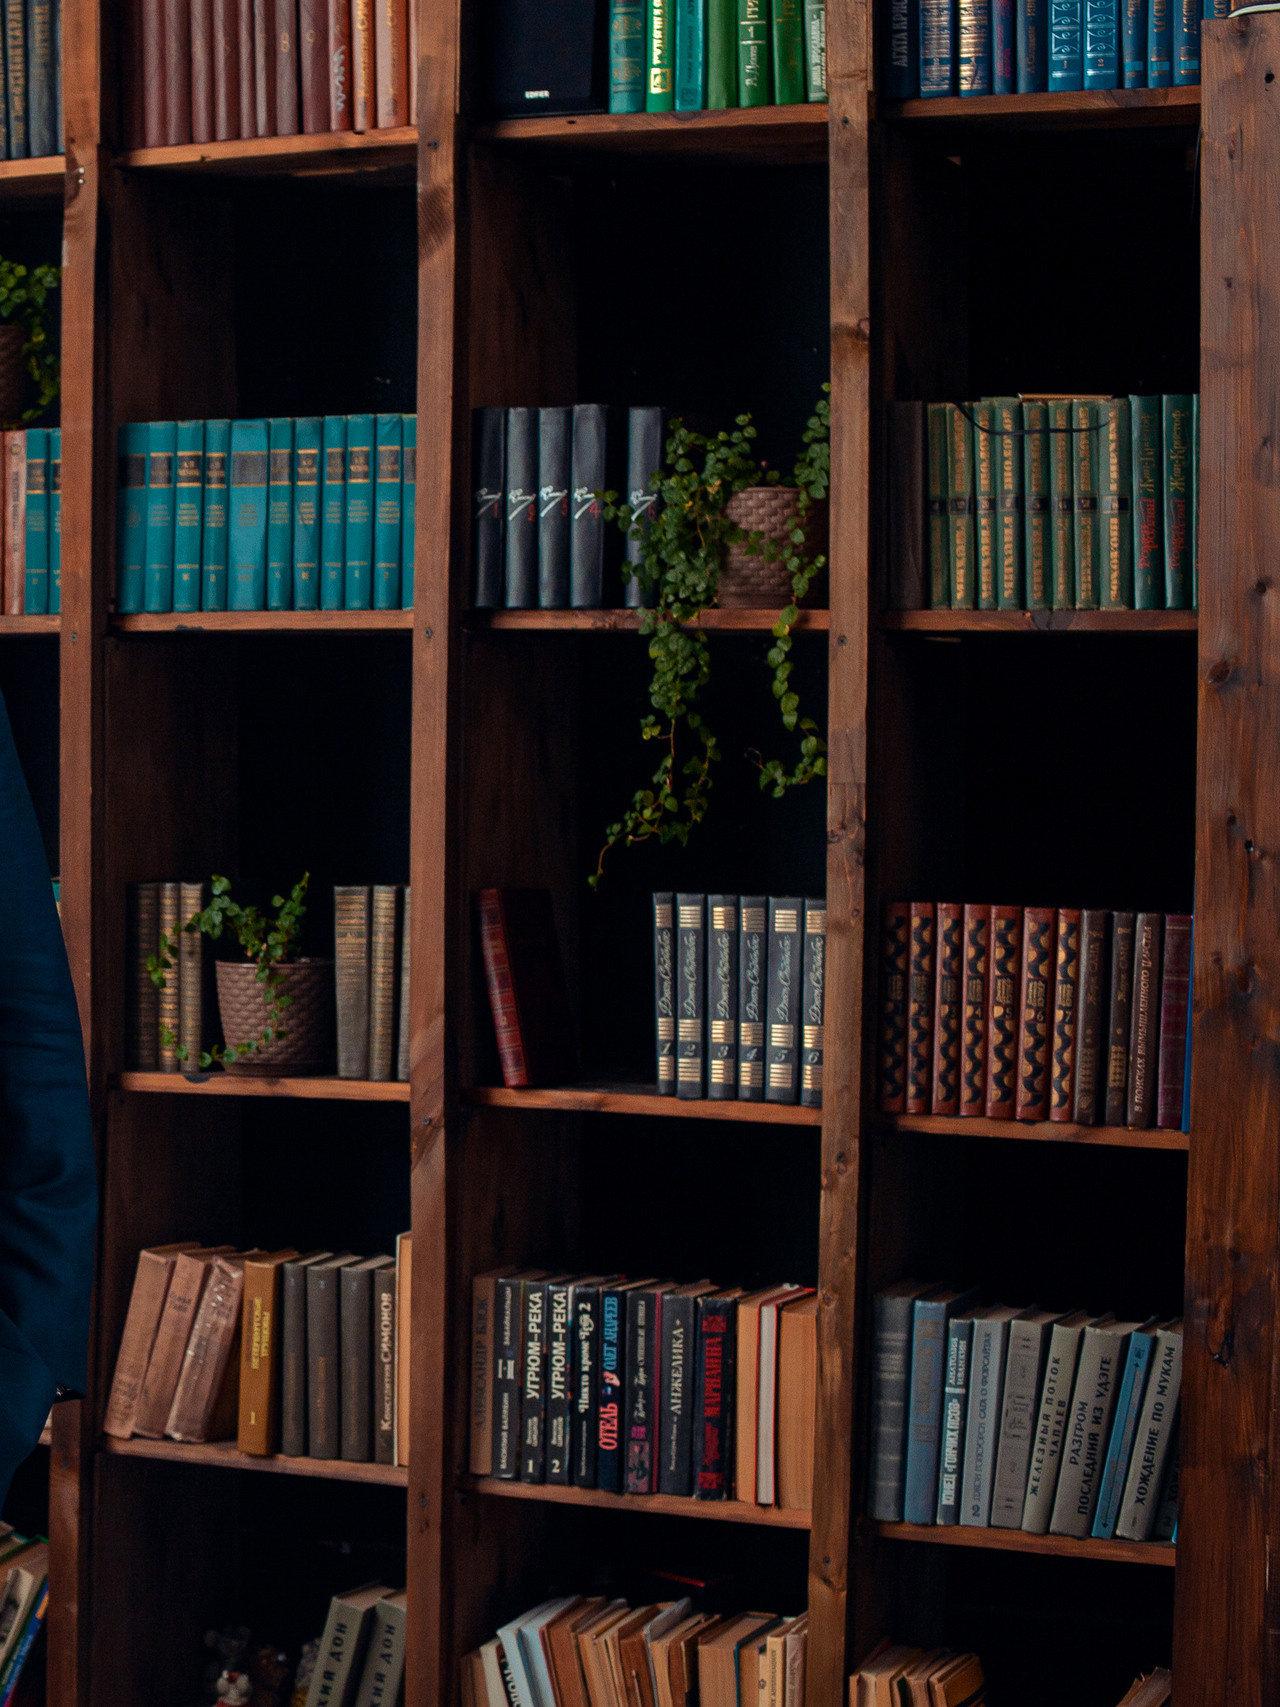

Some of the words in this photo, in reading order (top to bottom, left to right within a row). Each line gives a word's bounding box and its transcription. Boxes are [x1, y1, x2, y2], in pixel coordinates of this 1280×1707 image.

[891, 32, 908, 67] АГАТА
[527, 503, 536, 522] 2
[561, 497, 568, 517] 3
[588, 501, 601, 519] 4
[1141, 926, 1152, 968] ЦАРСТВА
[1005, 1006, 1013, 1019] 5
[1036, 1008, 1045, 1022] 6
[1064, 1010, 1073, 1023] 7
[1137, 969, 1150, 1056] ВЫМЫШЛЕННОГО
[661, 1043, 671, 1055] 1
[685, 1044, 696, 1056] 2
[717, 1046, 728, 1058] 3
[746, 1049, 758, 1061] 4
[775, 1049, 786, 1062] 5
[808, 1052, 820, 1064] 6
[1135, 1058, 1146, 1104] ПОИСКАХ
[1135, 1104, 1143, 1112] В
[475, 1297, 488, 1336] БЛОК
[578, 1302, 592, 1312] 2
[380, 1293, 393, 1363] СИМОНОВ
[525, 1292, 543, 1400] УГРЮМ-РЕКА
[551, 1292, 567, 1400] УГРЮМ-РЕКА
[603, 1343, 618, 1371] ОЛЕГ
[669, 1328, 684, 1416] АНЖЕЛИКА
[1156, 1345, 1175, 1398] МУКАМ
[474, 1342, 487, 1430] АЛЕКСАНДР
[577, 1375, 590, 1413] Никто
[703, 1337, 722, 1418] МАРИАННА
[1044, 1356, 1061, 1406] ПОТОК
[1095, 1357, 1112, 1399] УДЭГЕ
[380, 1364, 392, 1431] Константин
[1091, 1406, 1103, 1425] ИЗ
[1151, 1402, 1165, 1422] ПО
[599, 1402, 618, 1451] ОТЕЛЬ
[1049, 1400, 1066, 1458] ЧАПАЕВ
[1069, 1401, 1088, 1466] РАЗГРОМ
[551, 1459, 560, 1474] 2
[971, 1504, 980, 1518] 2
[980, 1389, 988, 1397] О
[1134, 1427, 1159, 1506] ХОЖДЕНИЕ
[941, 1474, 958, 1505] КОНЕЦ
[329, 1622, 348, 1663] ДОН
[378, 1623, 396, 1665] ДОН
